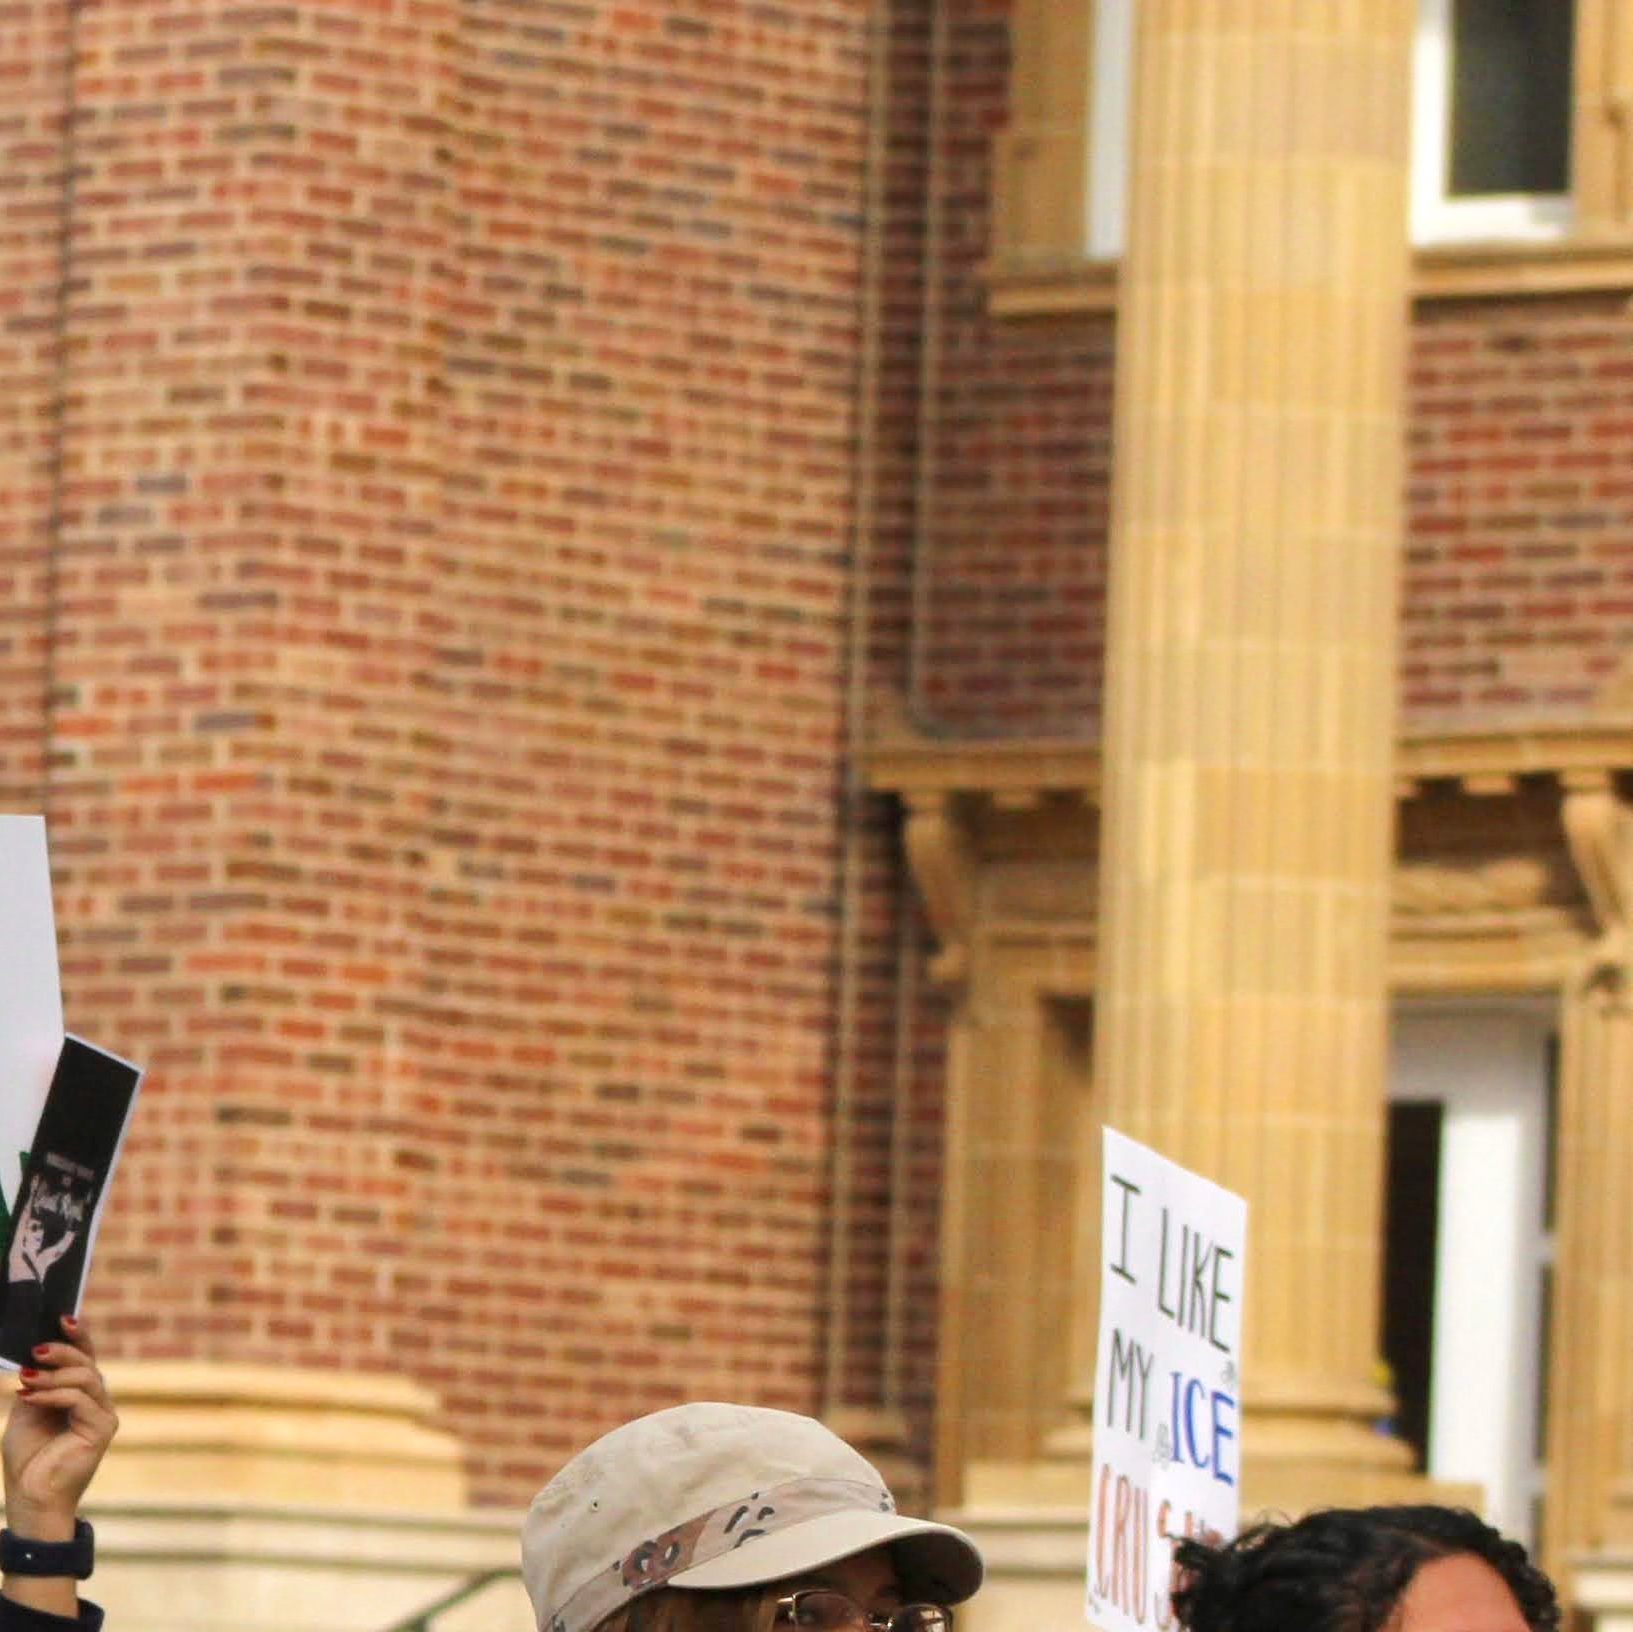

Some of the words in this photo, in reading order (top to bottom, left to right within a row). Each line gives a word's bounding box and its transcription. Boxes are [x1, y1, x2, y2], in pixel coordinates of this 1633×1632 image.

[1110, 1173, 1141, 1285] I
[1157, 1208, 1233, 1354] LIKE
[1107, 1328, 1152, 1441] MY
[1171, 1371, 1235, 1486] ICE
